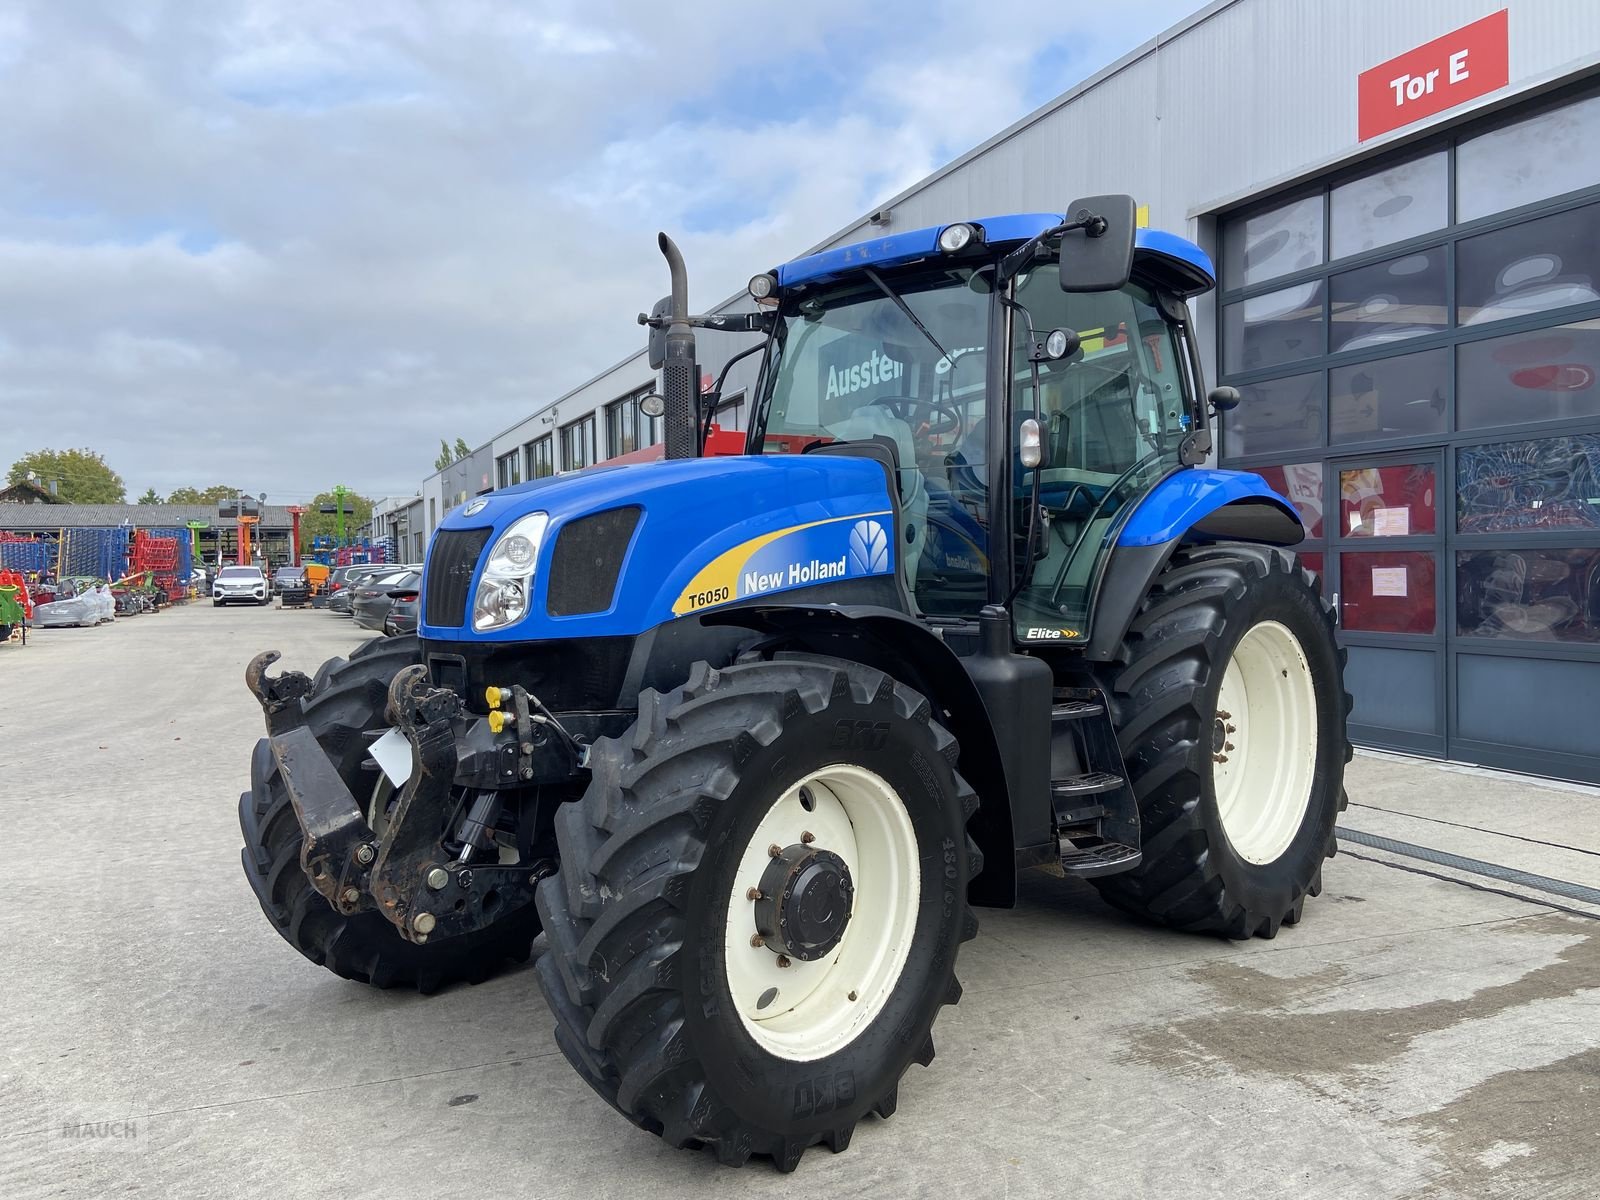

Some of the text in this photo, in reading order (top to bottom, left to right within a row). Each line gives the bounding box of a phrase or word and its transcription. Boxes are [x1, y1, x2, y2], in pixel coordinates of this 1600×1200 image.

[1390, 48, 1469, 107] Tor E
[744, 556, 846, 594] New Holland
[688, 586, 729, 609] T6050
[1026, 627, 1061, 639] Elite
[832, 720, 890, 749] BKT
